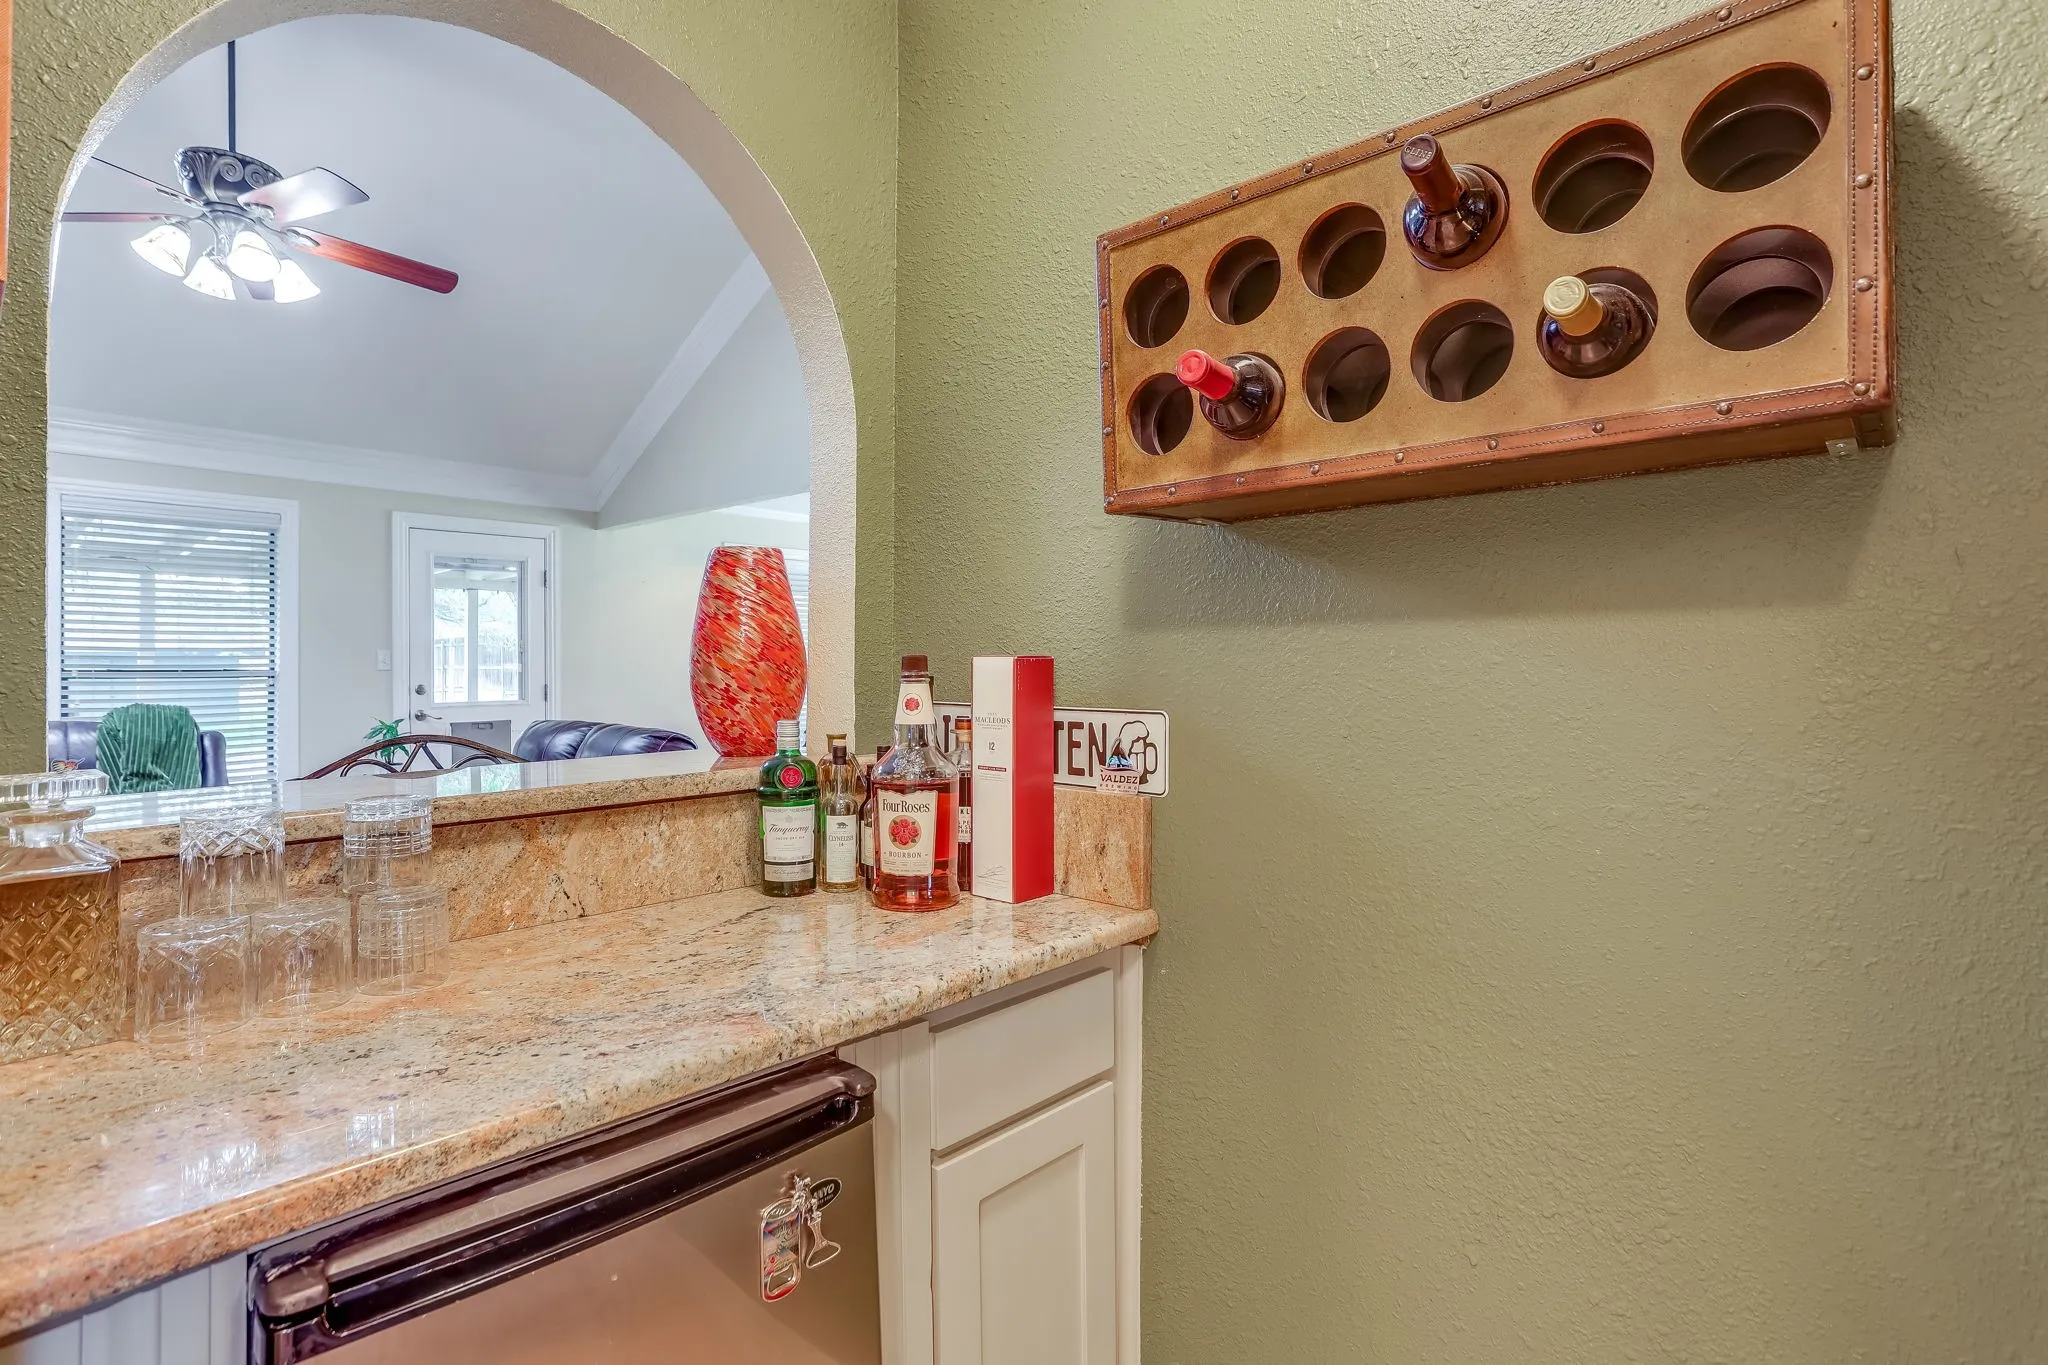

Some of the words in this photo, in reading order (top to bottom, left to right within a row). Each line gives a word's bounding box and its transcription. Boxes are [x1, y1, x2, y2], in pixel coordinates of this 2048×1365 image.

[1100, 774, 1138, 785] VALDEZ
[882, 798, 900, 813] Four
[901, 800, 930, 813] Roses
[889, 851, 922, 859] BOURBON
